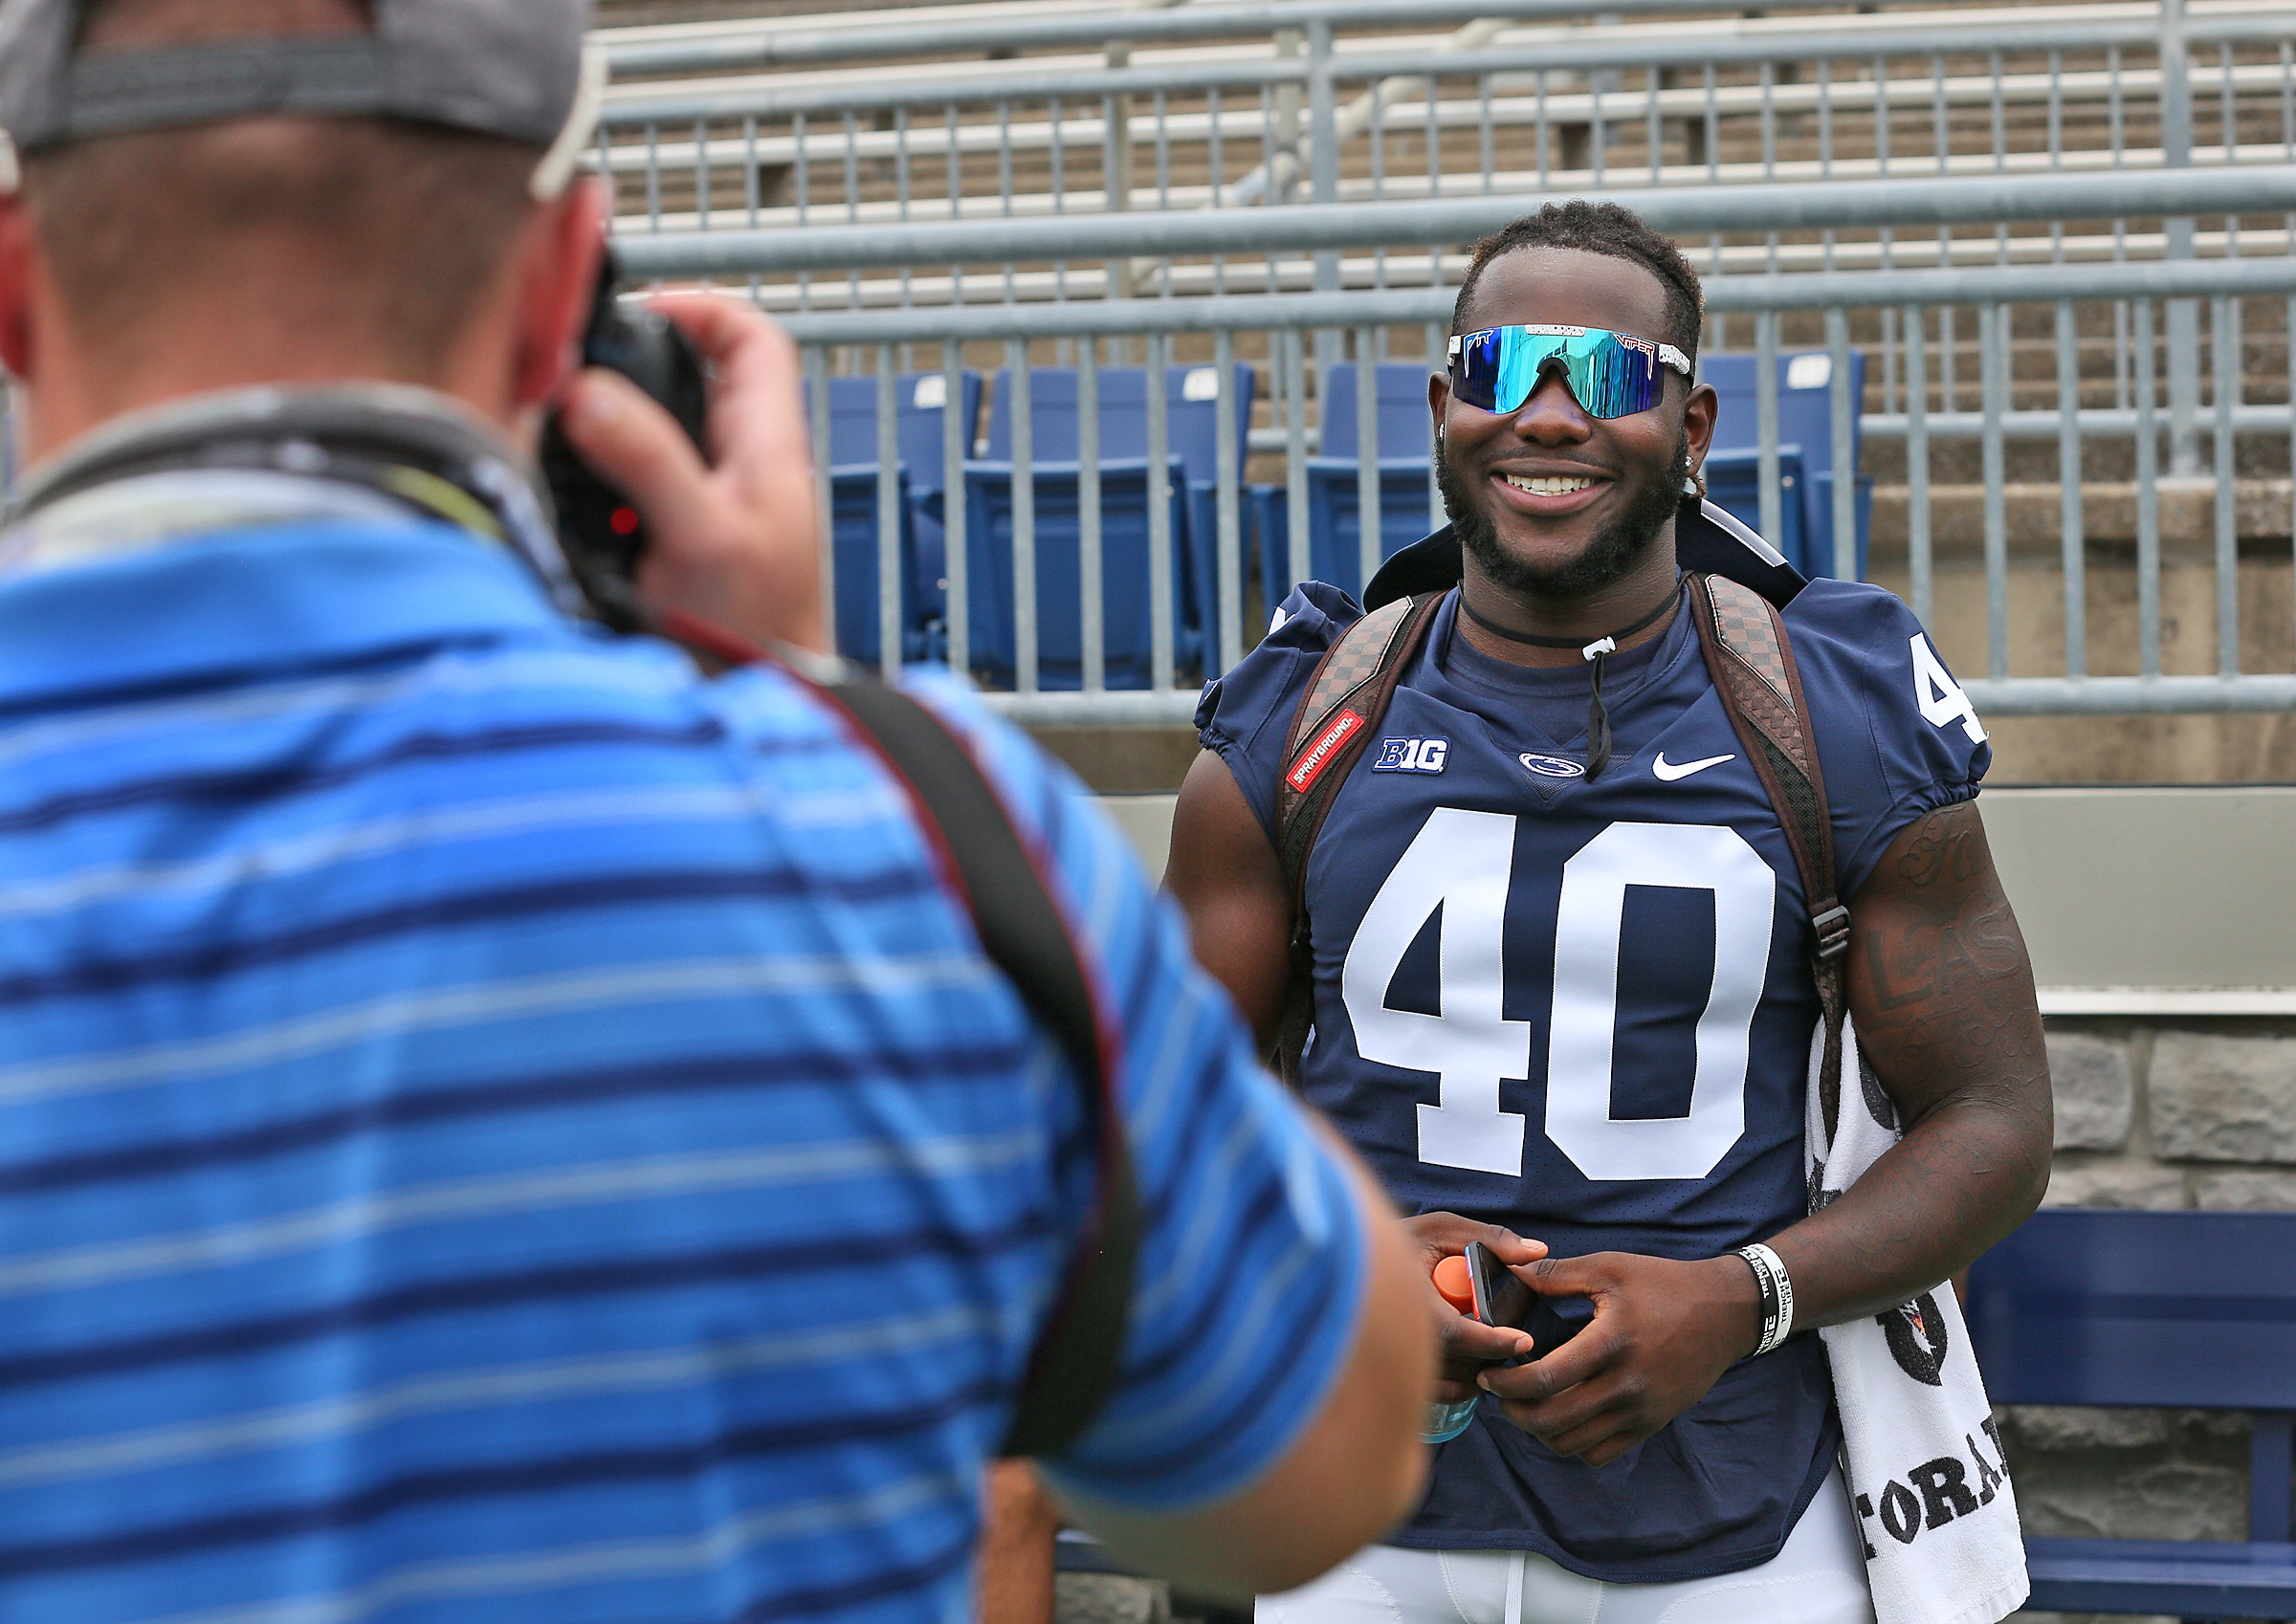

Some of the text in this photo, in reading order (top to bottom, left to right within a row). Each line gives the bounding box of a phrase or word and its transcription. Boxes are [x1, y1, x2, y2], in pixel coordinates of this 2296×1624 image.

[1613, 334, 1655, 381] VIPER
[1342, 806, 1777, 1181] 40
[1779, 1284, 1788, 1324] TRENCH
